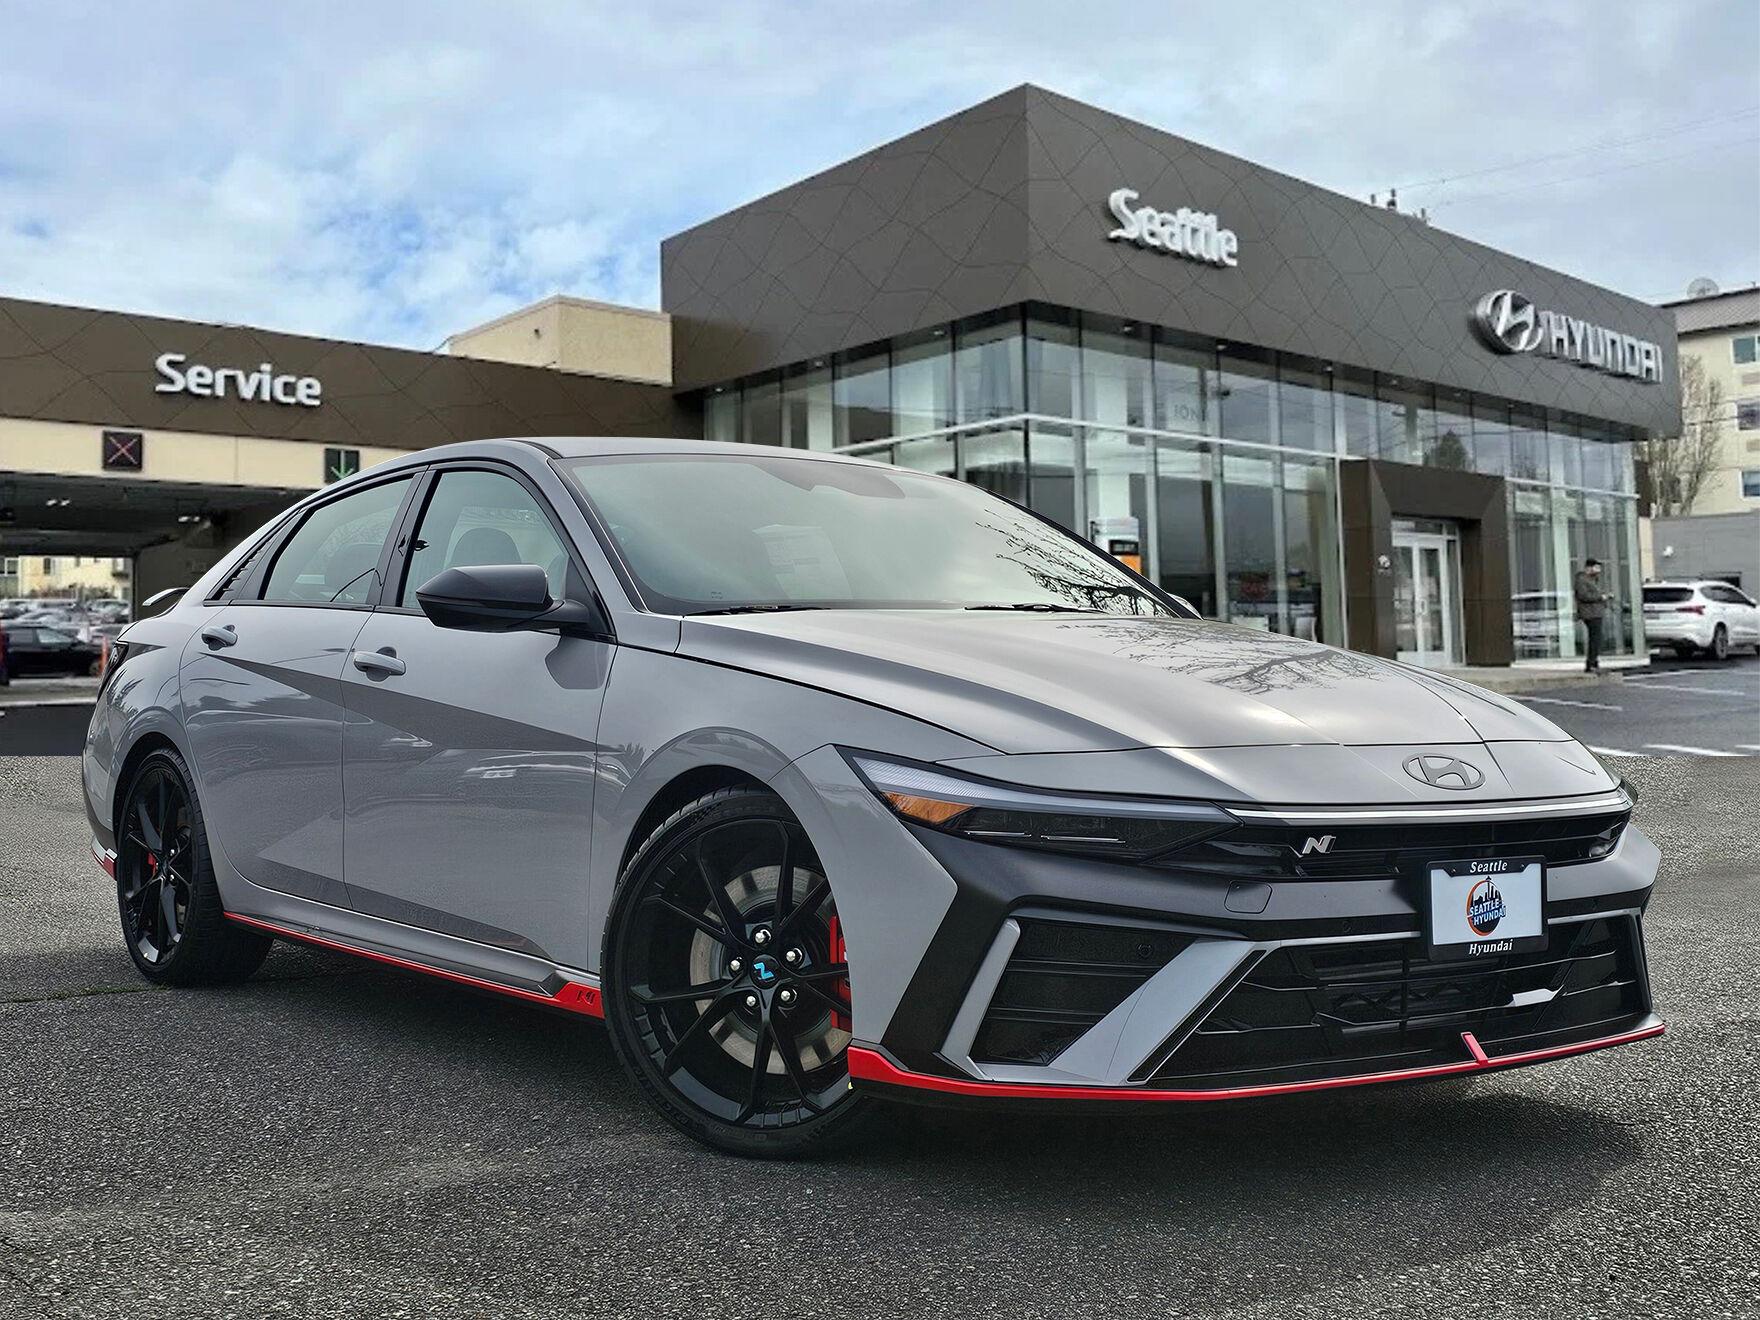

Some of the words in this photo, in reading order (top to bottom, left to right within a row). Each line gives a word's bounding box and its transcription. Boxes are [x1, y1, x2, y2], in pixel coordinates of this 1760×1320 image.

[1108, 188, 1237, 267] Seattle
[1545, 311, 1662, 382] HYUNDAI
[155, 353, 322, 407] Service
[1470, 860, 1508, 874] Seattle
[1469, 899, 1501, 917] SEATTLE
[1473, 905, 1507, 926] HYUNDAI
[1469, 939, 1514, 956] Hyundai
